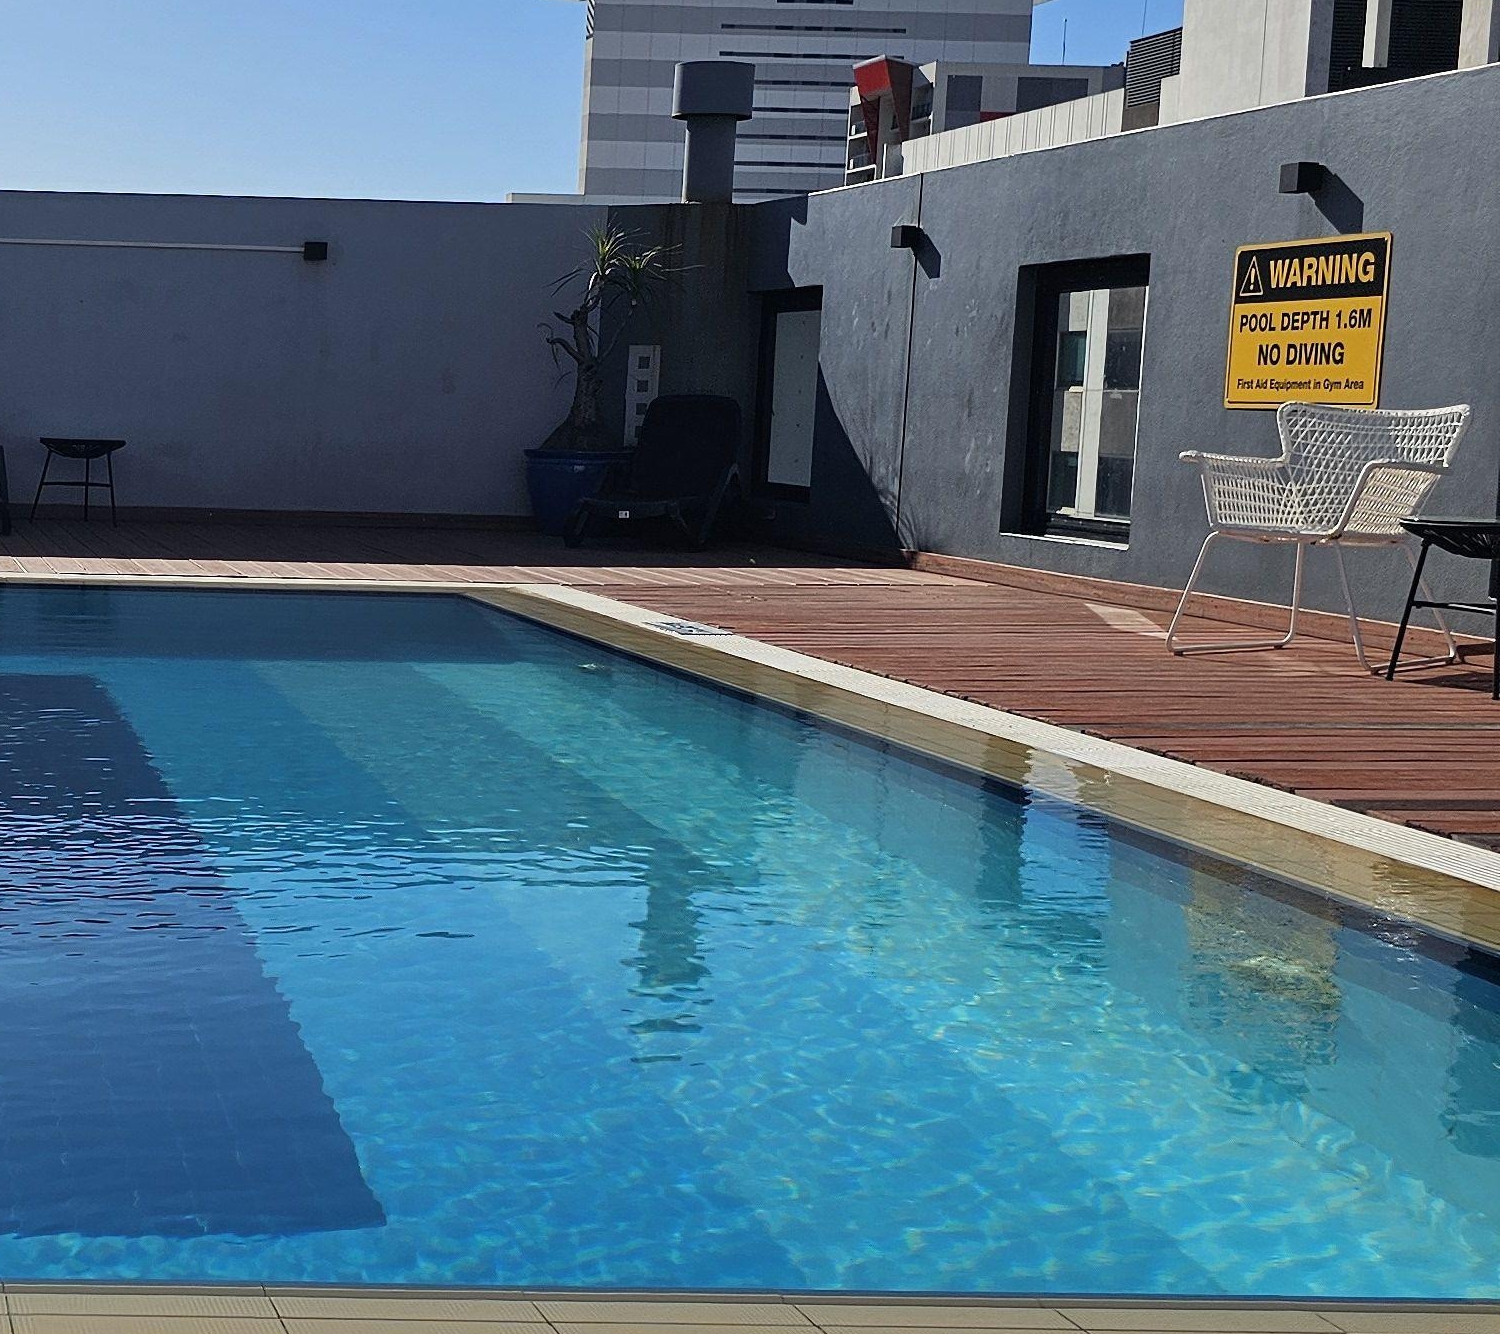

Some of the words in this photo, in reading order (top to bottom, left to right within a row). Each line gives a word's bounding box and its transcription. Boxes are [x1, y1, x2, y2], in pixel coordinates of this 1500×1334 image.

[1269, 251, 1376, 289] WARNING
[1239, 313, 1276, 333] POOL
[1280, 310, 1330, 332] DEPTH
[1335, 308, 1372, 330] 1.6M
[1257, 343, 1281, 366] NO
[1285, 342, 1345, 366] DIVING
[1236, 378, 1254, 390] First
[1255, 378, 1268, 390] Aid
[1269, 378, 1311, 392] Equipment
[1313, 378, 1321, 390] in
[1323, 378, 1342, 392] Gym
[1343, 378, 1364, 390] Area
